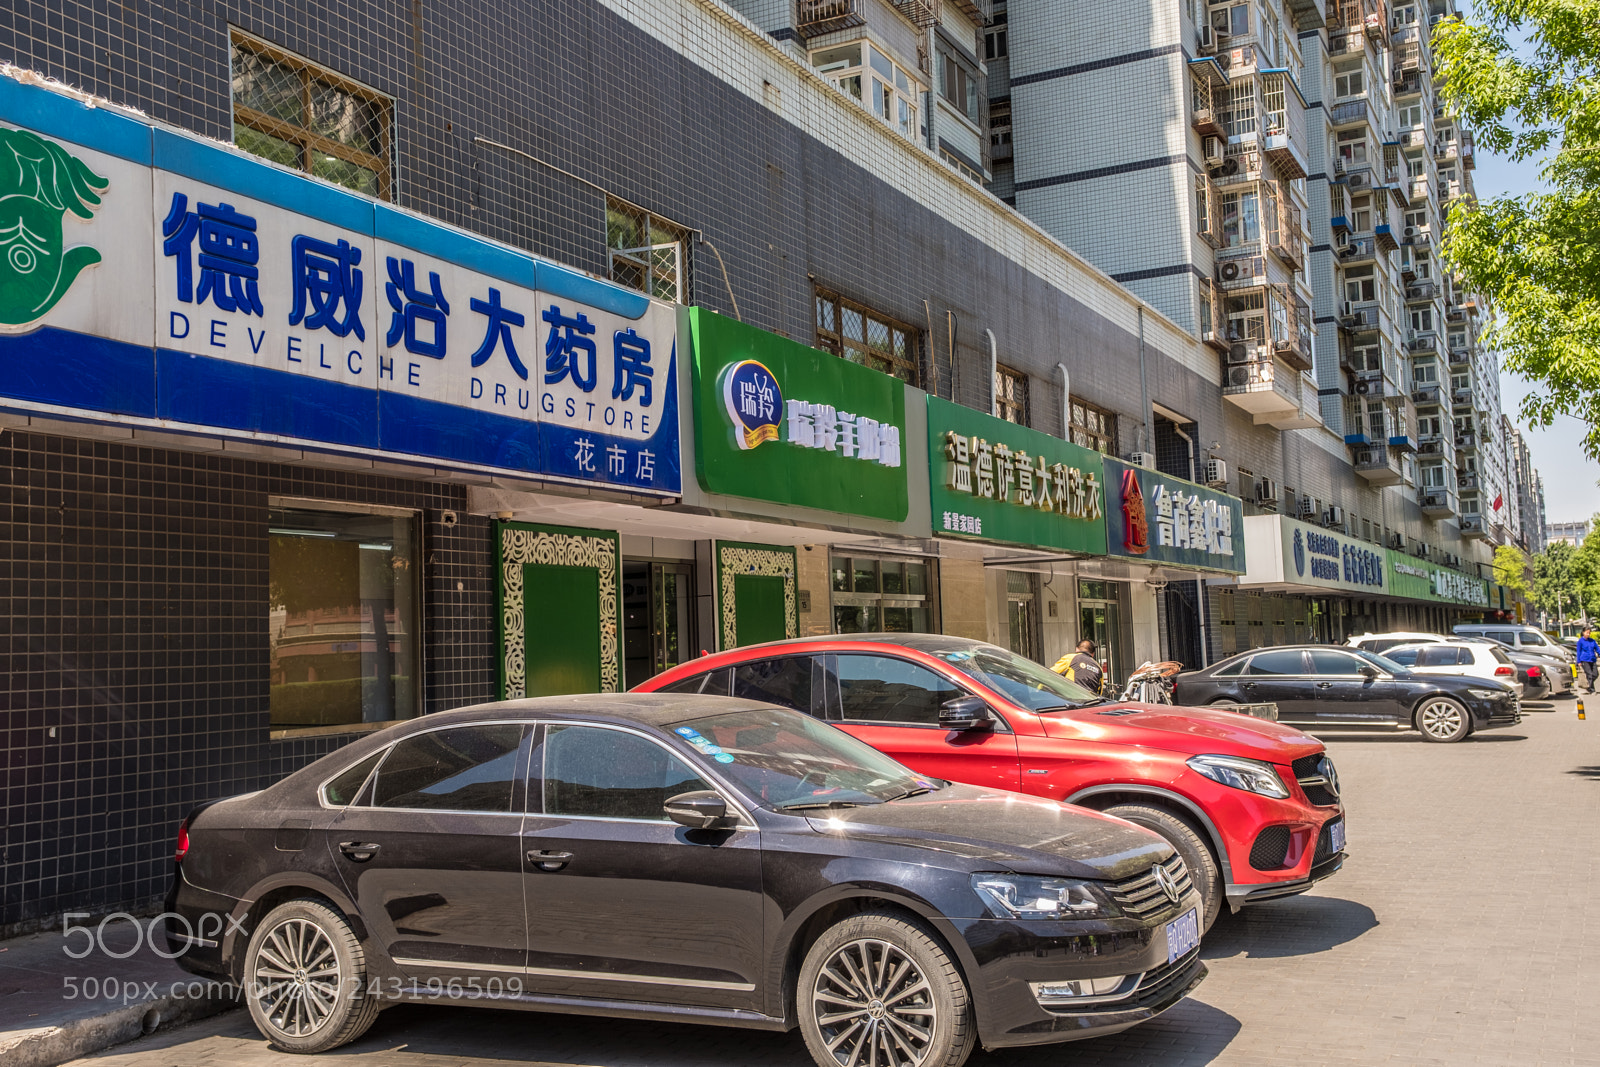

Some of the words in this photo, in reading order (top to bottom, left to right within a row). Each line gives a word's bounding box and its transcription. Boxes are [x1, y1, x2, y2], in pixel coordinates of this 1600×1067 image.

[163, 192, 654, 407] 德威治大药房
[170, 311, 420, 386] DEVELCHE
[471, 378, 650, 434] DRUGSTORE
[574, 437, 656, 480] 花市店
[945, 431, 1102, 520] 温德萨意大利洗衣
[942, 511, 982, 535] 新景家园店
